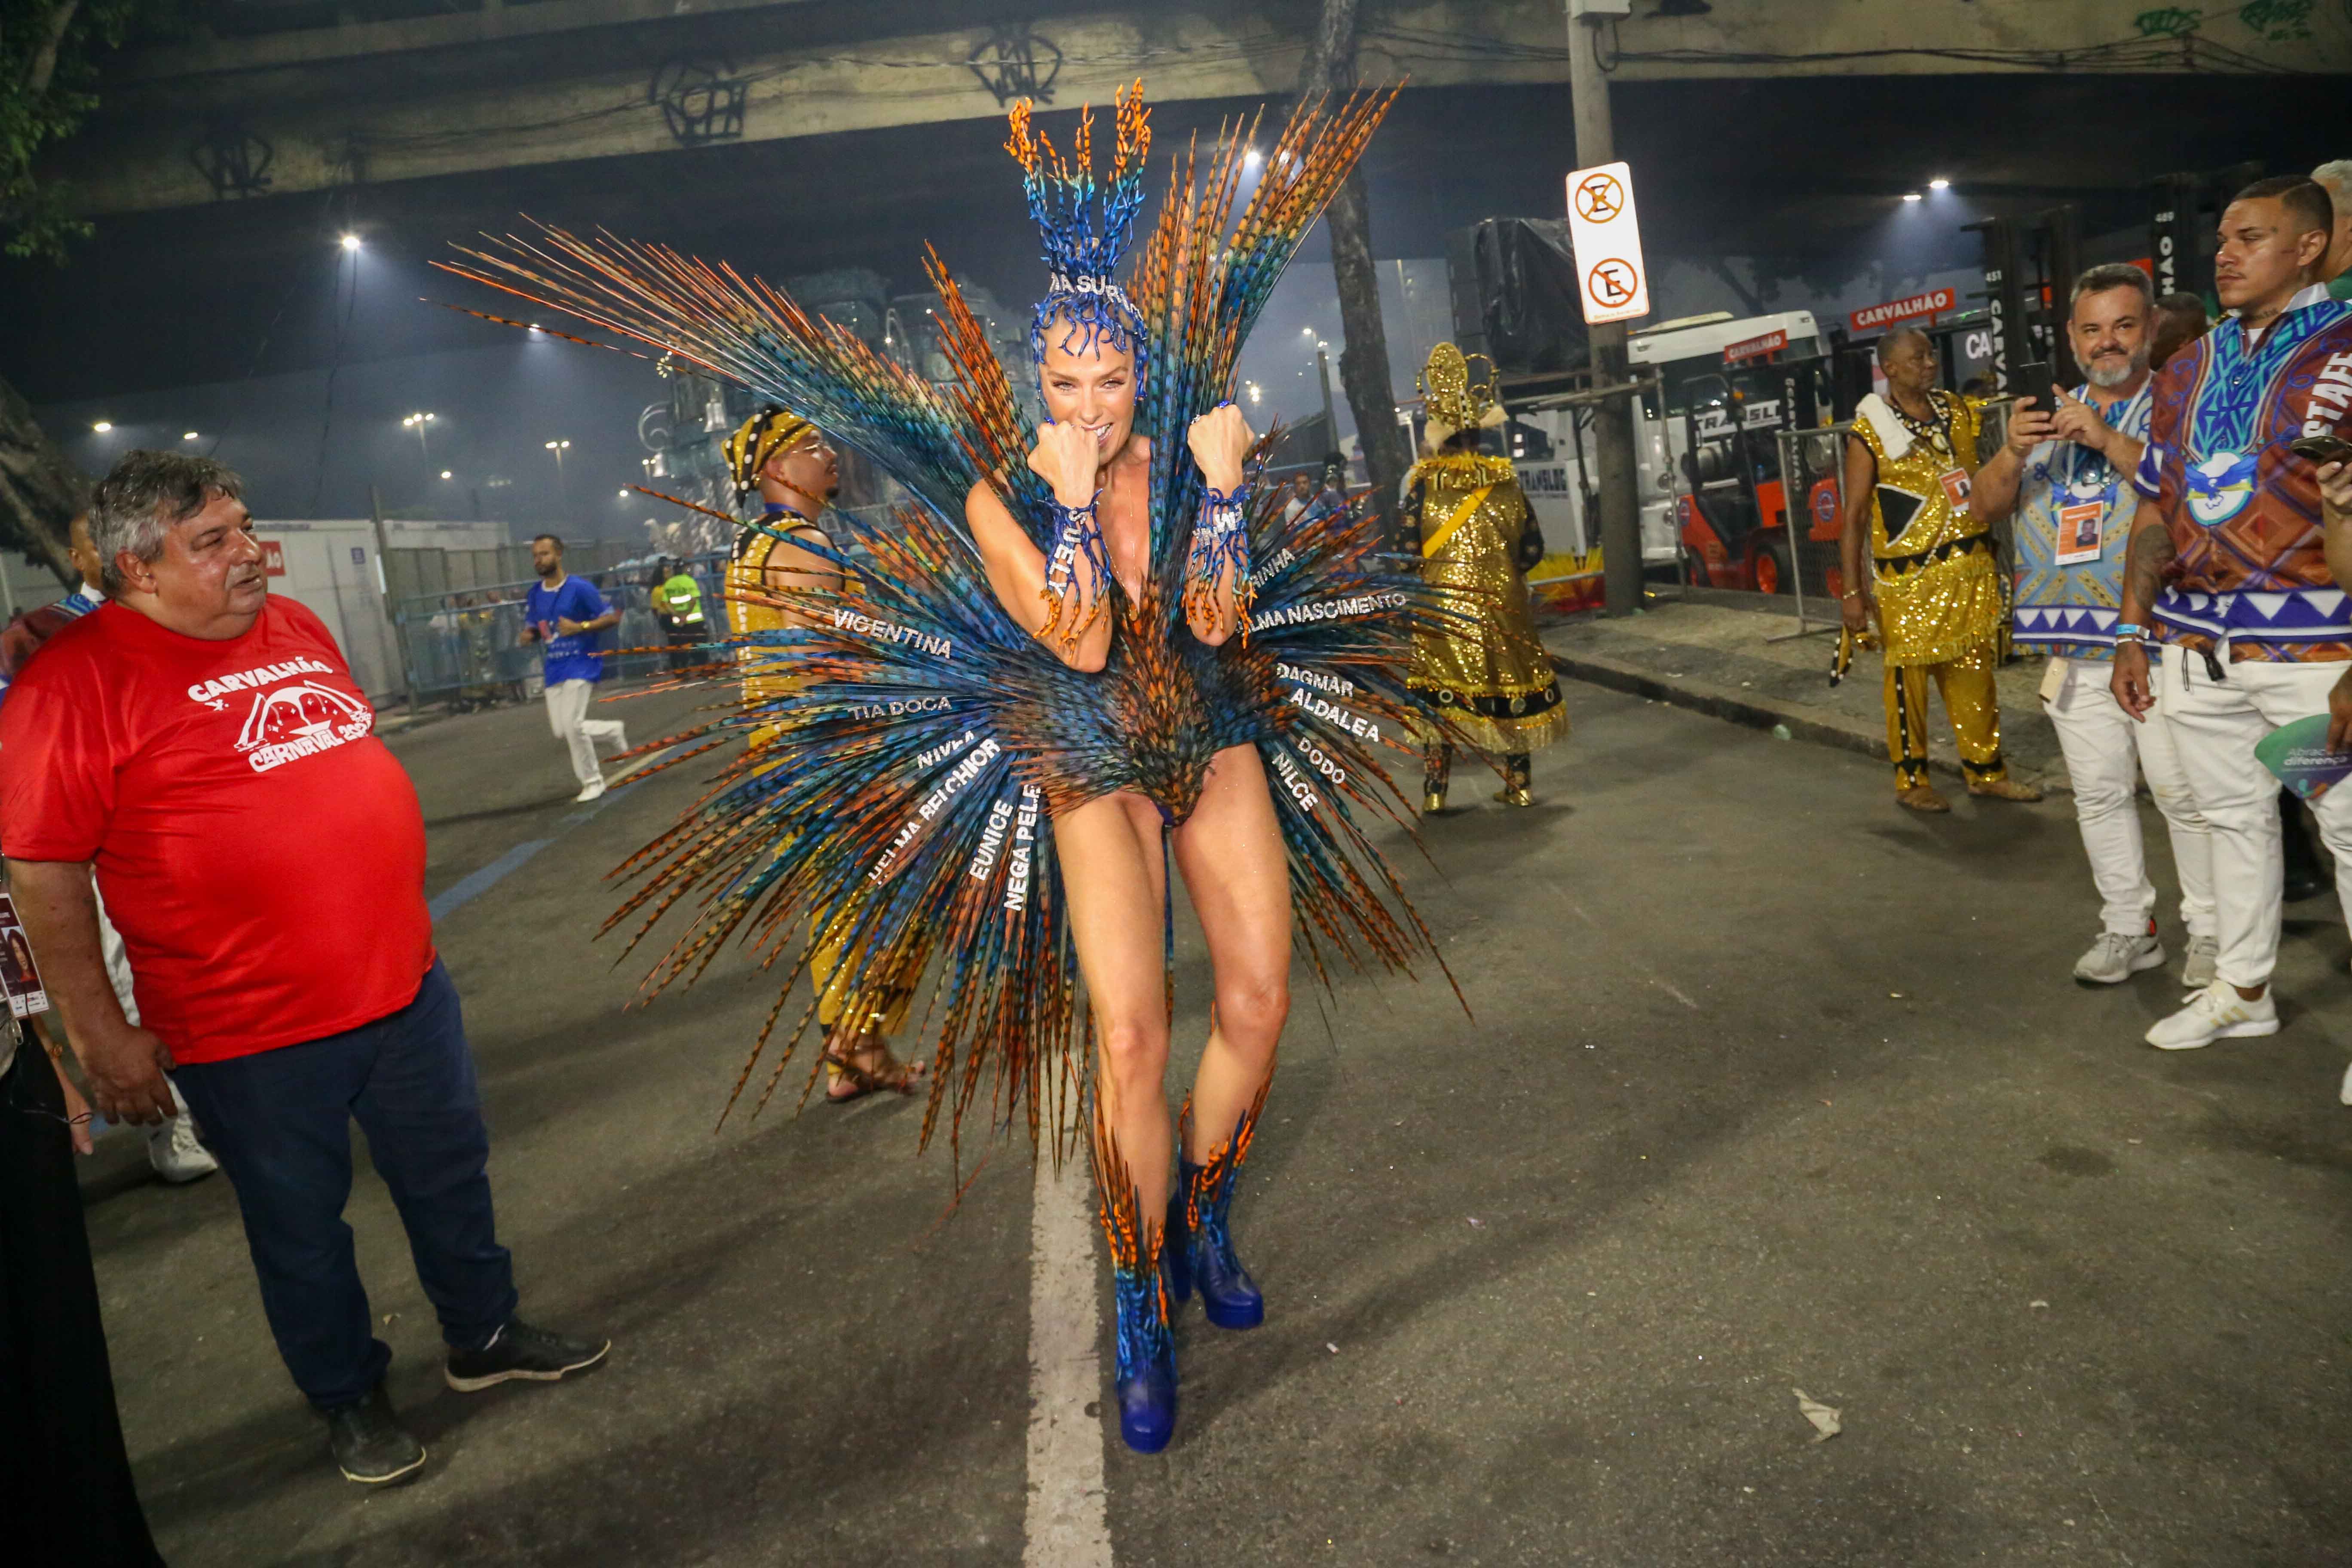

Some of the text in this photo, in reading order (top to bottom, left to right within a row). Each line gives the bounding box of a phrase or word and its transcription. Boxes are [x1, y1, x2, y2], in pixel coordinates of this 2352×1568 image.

[1857, 292, 1947, 326] CARVALHÃO
[1246, 548, 1295, 596] RINHA
[1287, 592, 1406, 625] NASCIMENTO
[833, 609, 951, 659] VICENTINA
[188, 656, 333, 702] CARVALHÃO
[1277, 663, 1354, 698] DAGMAR
[848, 696, 952, 720] TIA DOCA
[1290, 687, 1379, 743] ALDALEA
[248, 732, 345, 772] CARNAVAL
[1298, 737, 1346, 784] DODO
[919, 738, 1001, 821] BELCHIOR
[1272, 752, 1319, 812] NILCE
[969, 799, 1014, 881] EUNICE
[1004, 846, 1031, 912] NEGA
